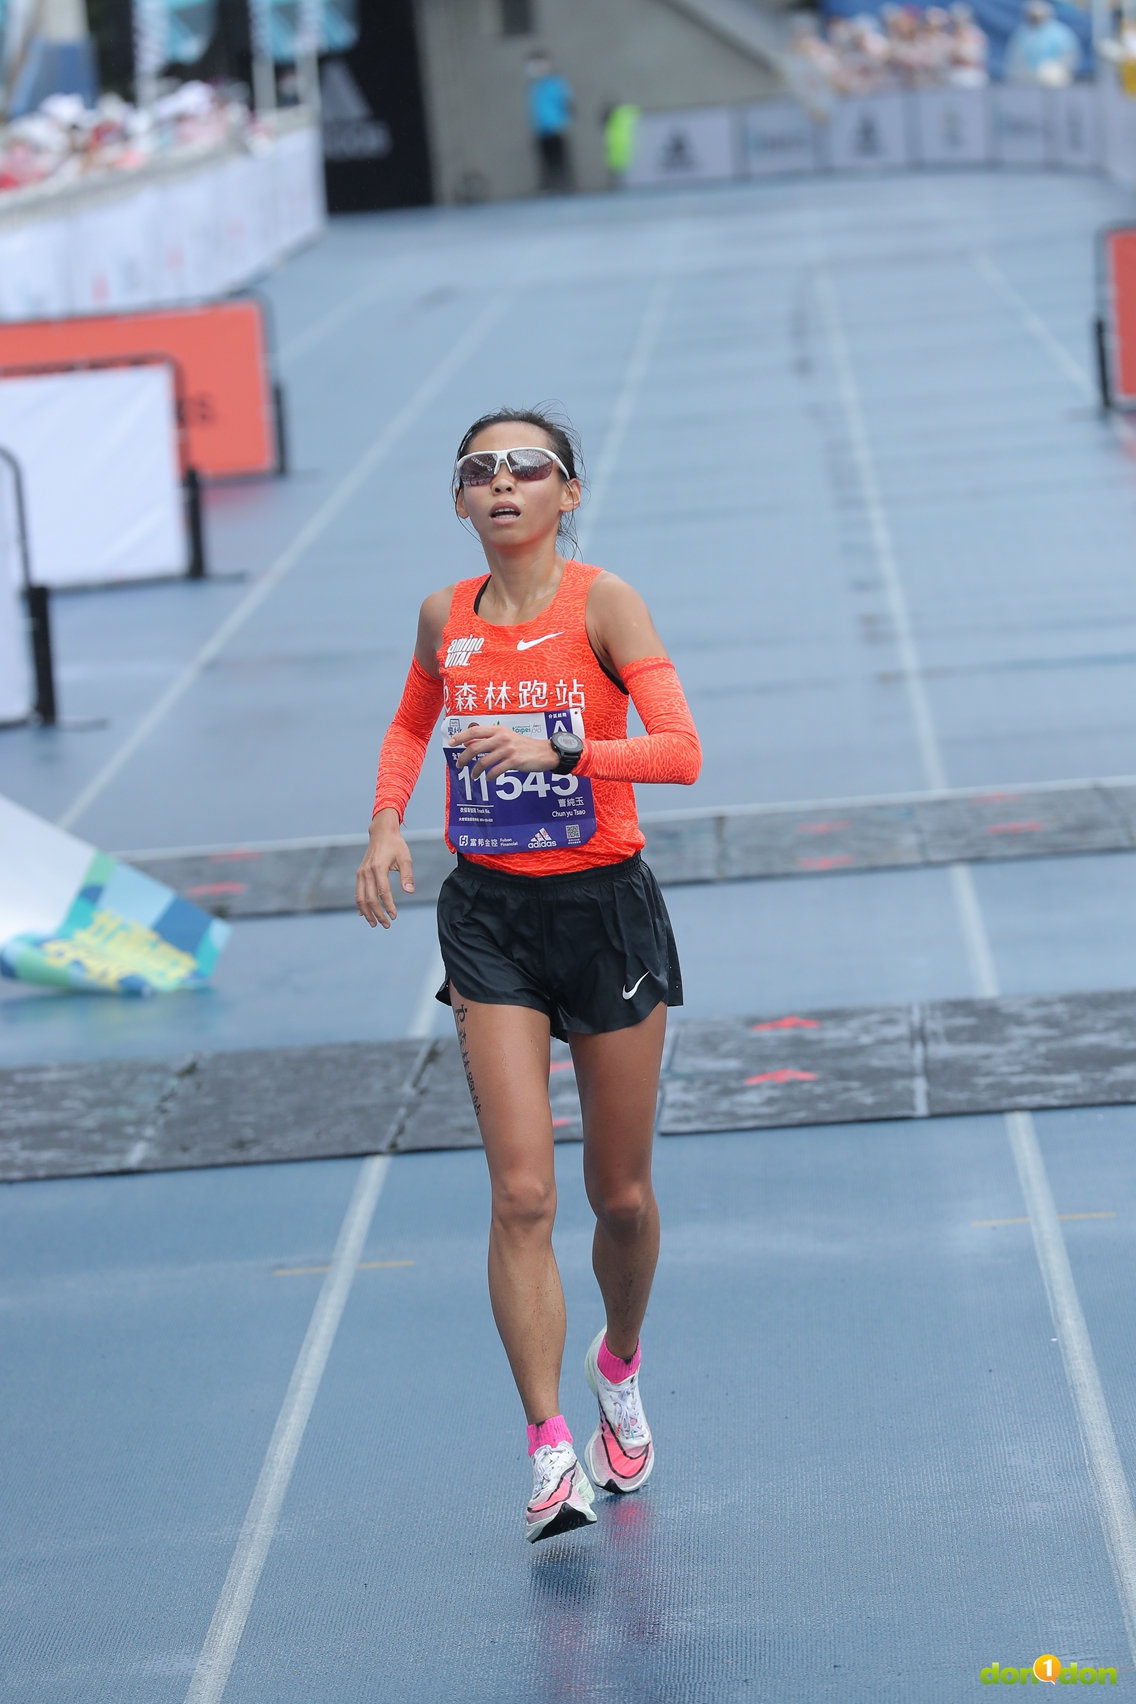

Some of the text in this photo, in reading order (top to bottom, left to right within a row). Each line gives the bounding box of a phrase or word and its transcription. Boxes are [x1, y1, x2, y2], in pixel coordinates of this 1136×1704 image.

[447, 634, 484, 652] amino
[445, 651, 471, 668] VITAL
[457, 765, 579, 801] 11545
[528, 840, 557, 849] adidas
